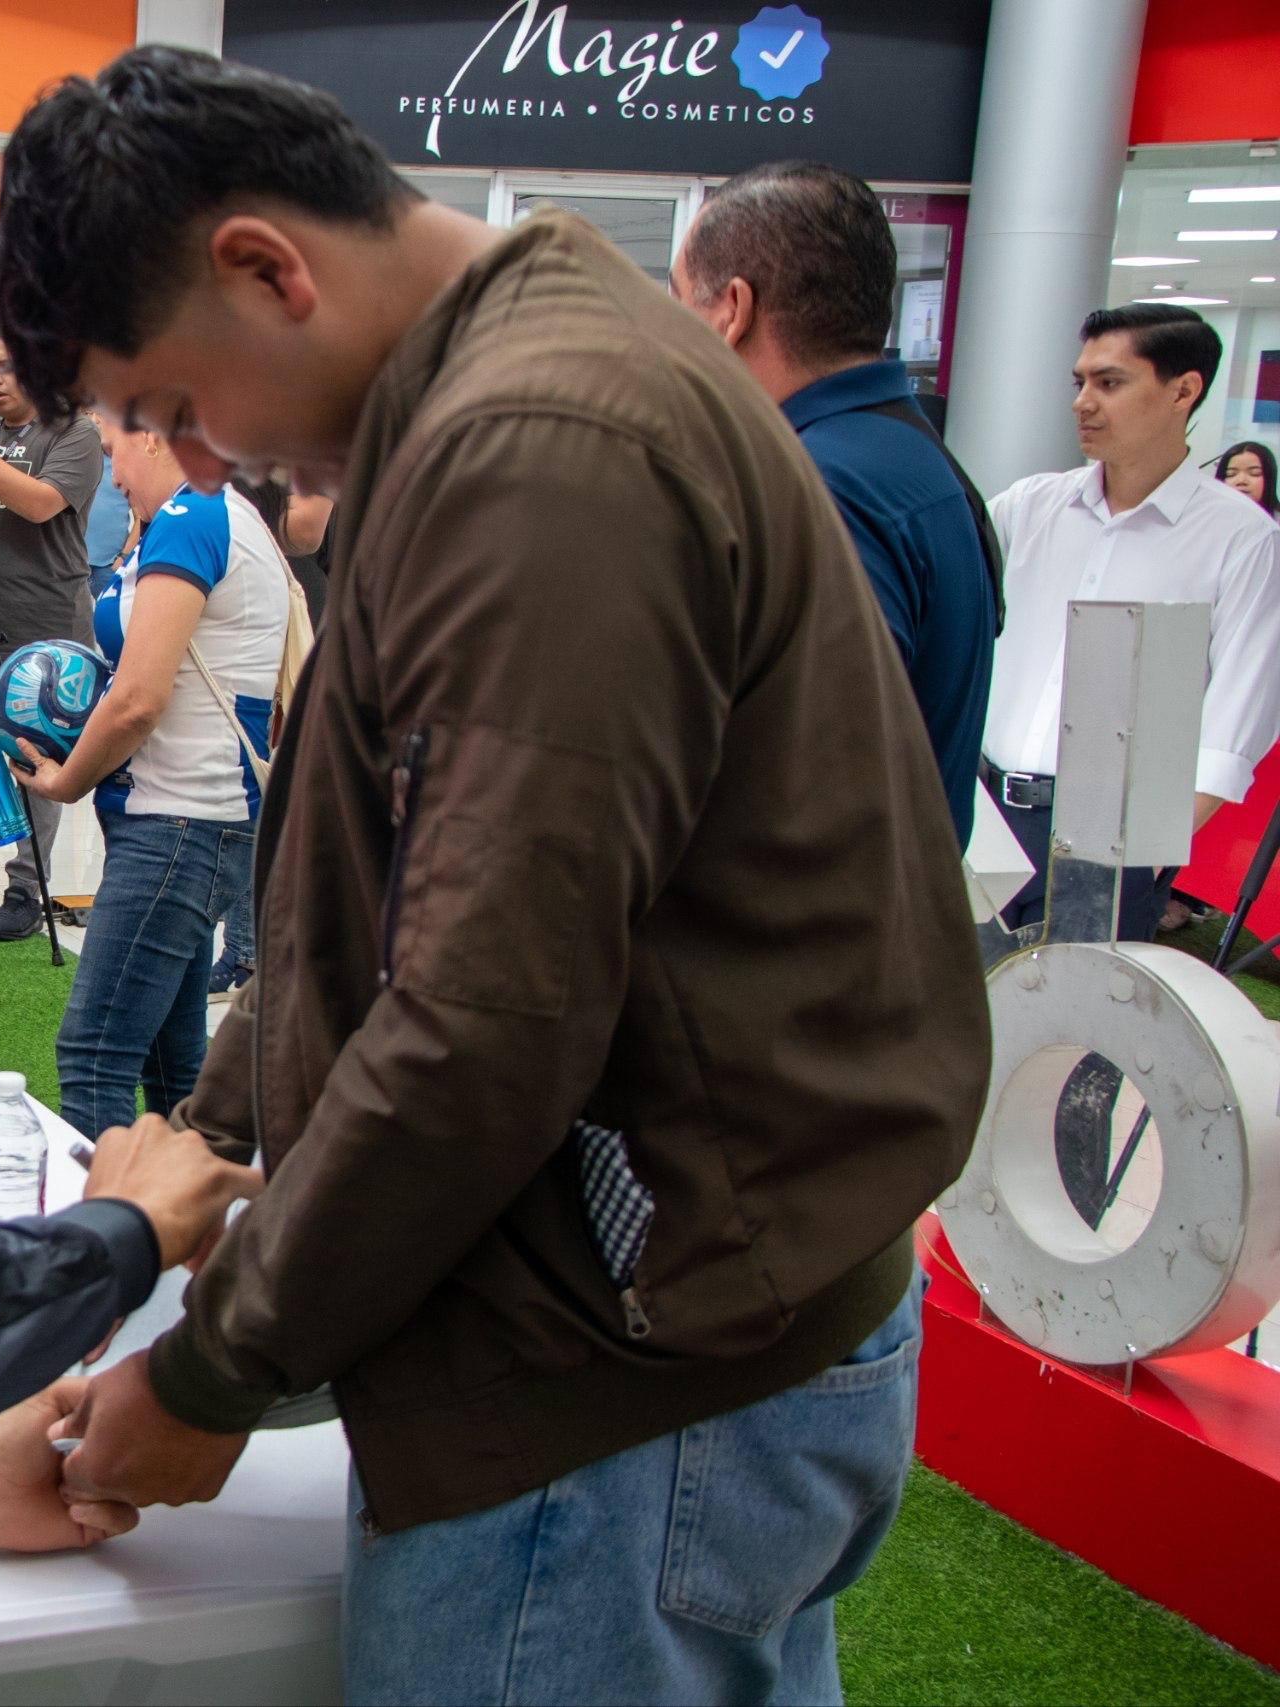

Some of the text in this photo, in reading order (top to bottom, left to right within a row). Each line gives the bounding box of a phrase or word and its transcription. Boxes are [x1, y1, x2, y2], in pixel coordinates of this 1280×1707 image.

[400, 96, 815, 124] PERFUMERIA COSMETICOS
[426, 0, 719, 158] Magie
